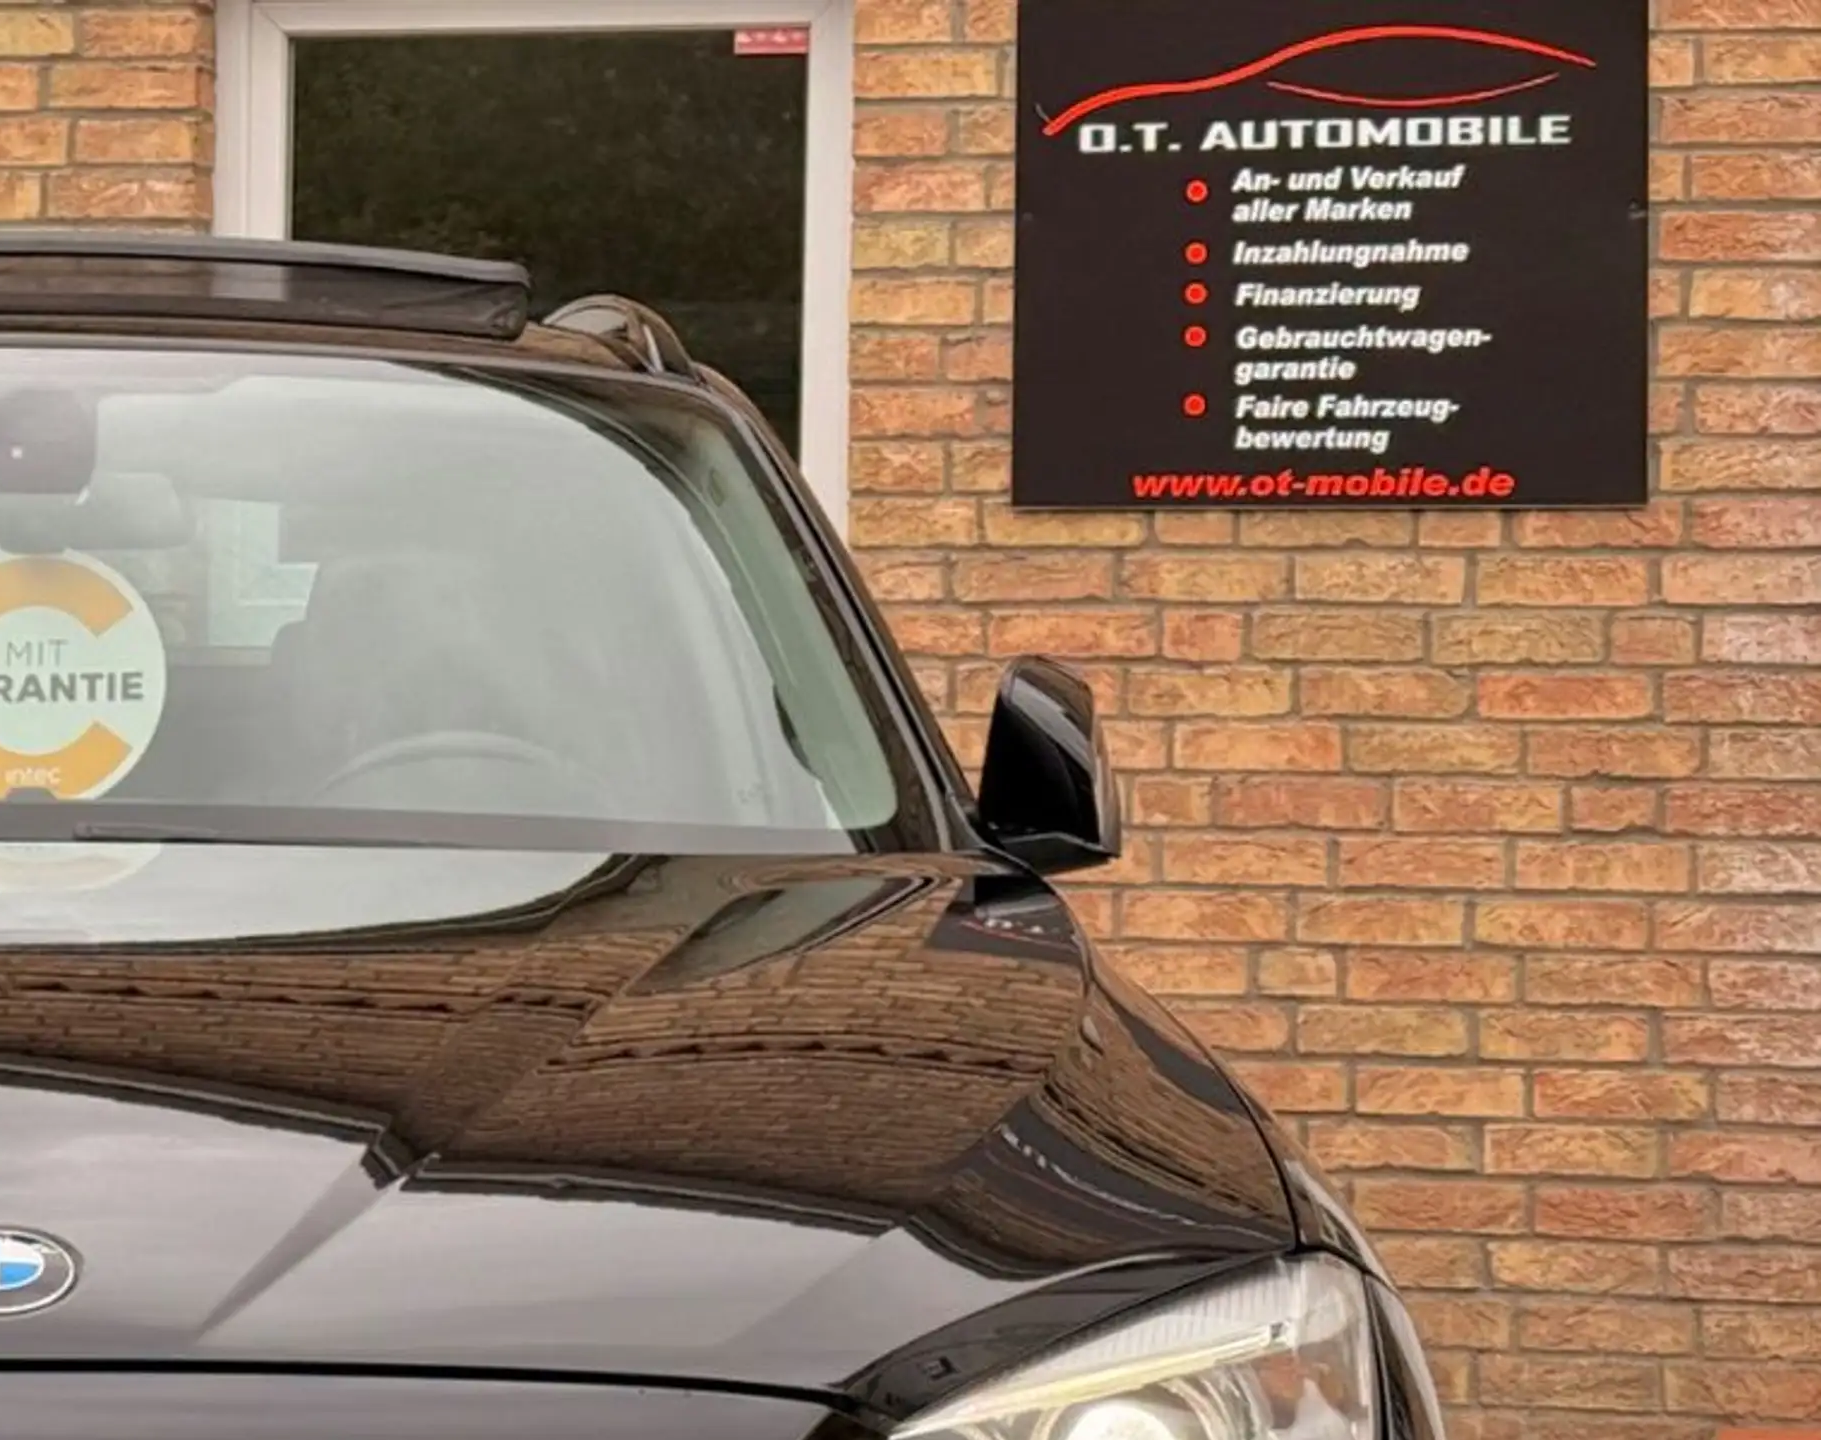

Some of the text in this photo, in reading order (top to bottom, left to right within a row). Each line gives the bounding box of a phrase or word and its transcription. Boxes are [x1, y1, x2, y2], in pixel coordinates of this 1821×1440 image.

[1078, 115, 1572, 153] O.T. AUTOMOBILE
[1232, 164, 1466, 193] An- und Verkauf
[1232, 197, 1412, 223] aller Marken
[1232, 239, 1470, 268] Inzahlungnahme
[1234, 281, 1422, 312] Finanzierung
[1235, 324, 1492, 354] Gebrauchtwagen-
[1234, 356, 1356, 386] garantie
[1235, 394, 1460, 424] Faire Fahrzeug-
[1234, 425, 1390, 455] bewertung
[1132, 466, 1515, 497] www.ot-mobile.de
[5, 638, 68, 668] MIT
